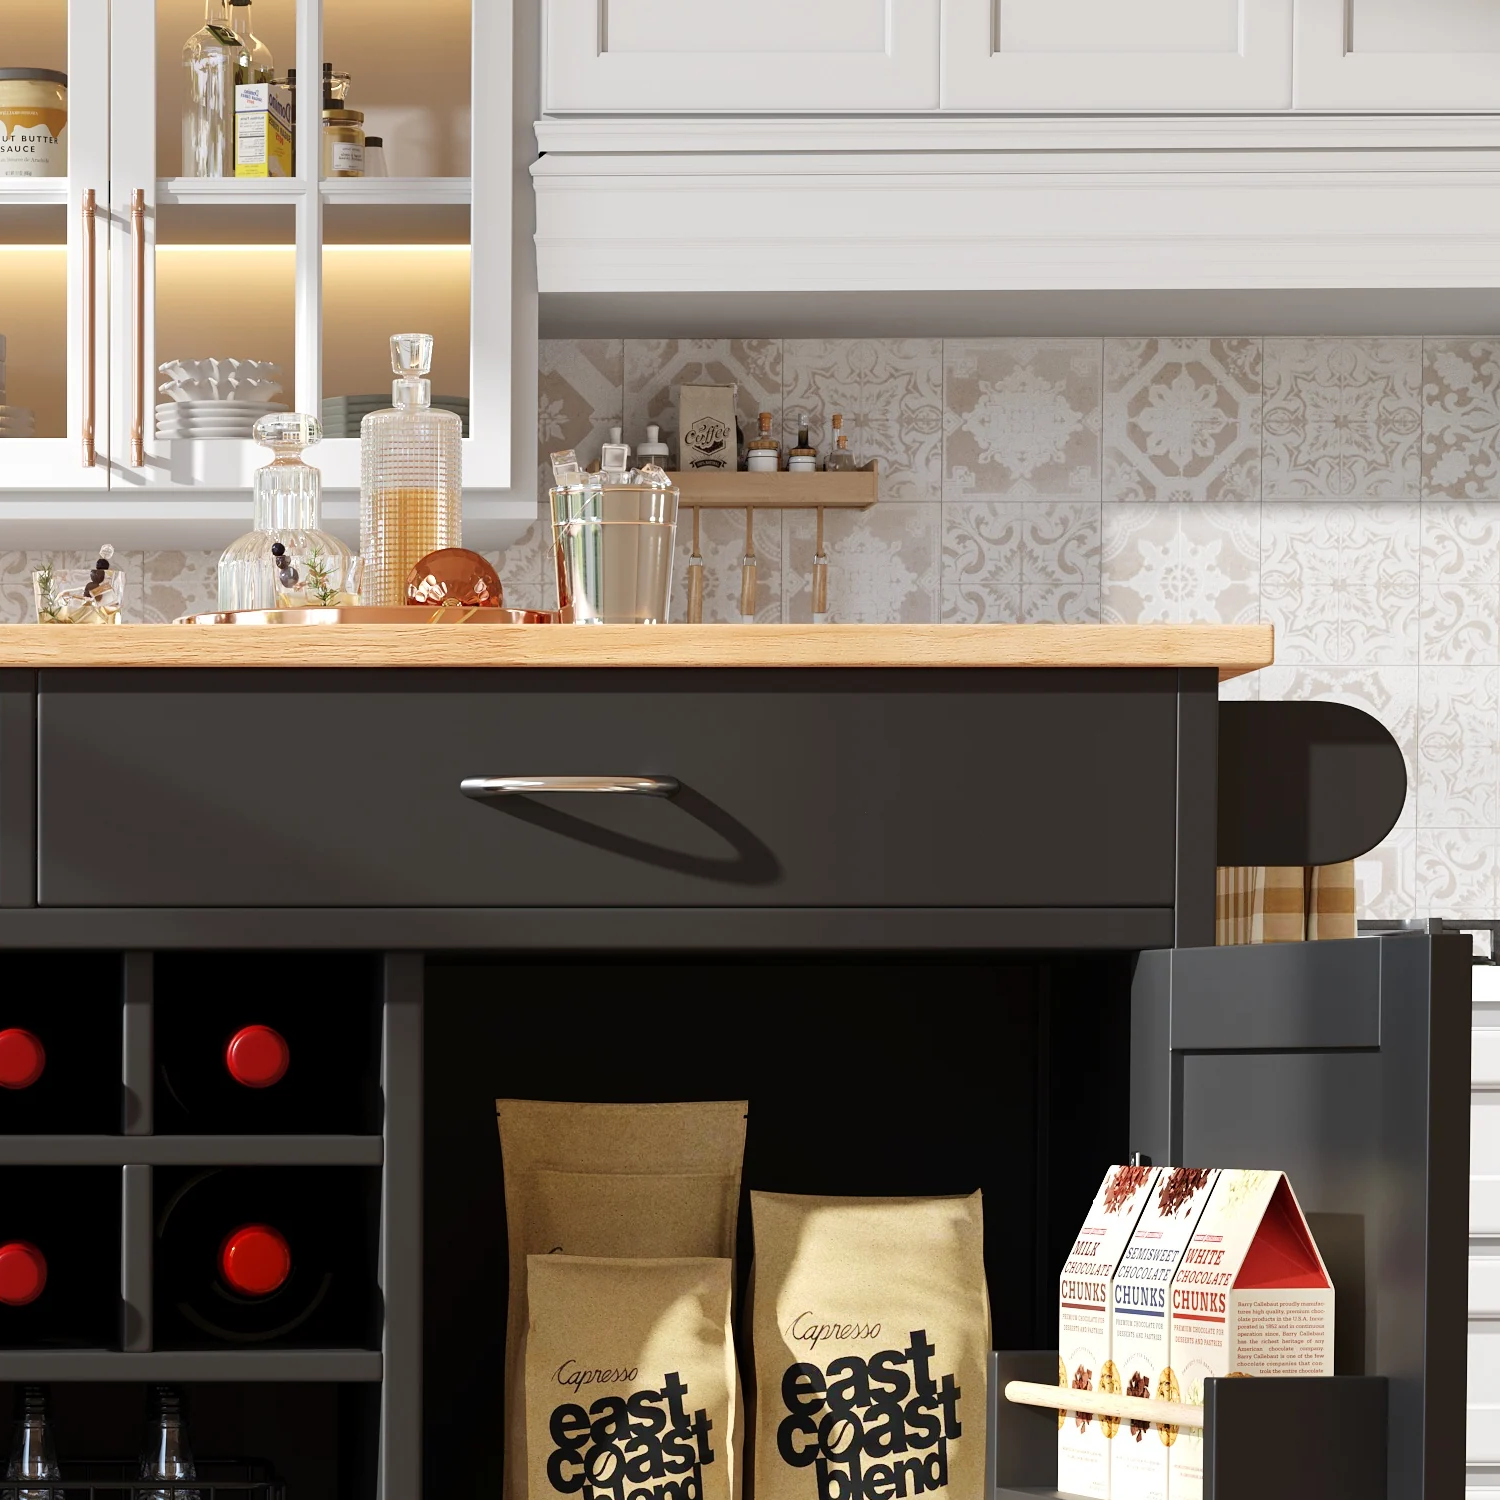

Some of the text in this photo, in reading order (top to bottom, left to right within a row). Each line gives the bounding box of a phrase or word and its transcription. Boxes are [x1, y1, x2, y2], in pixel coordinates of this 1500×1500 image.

[0, 145, 36, 153] SAUCE
[21, 135, 59, 145] BUTTER
[684, 424, 731, 446] Coffee
[1072, 1240, 1101, 1257] MILK
[1125, 1247, 1180, 1262] SEMISWEET
[1185, 1248, 1226, 1266] WHITE
[1064, 1261, 1113, 1277] CHOCOLATE
[1117, 1265, 1172, 1282] CHOCOLATE
[1176, 1269, 1233, 1286] CHOCOLATE
[1061, 1279, 1107, 1303] CHUNKS
[1114, 1284, 1165, 1308] CHUNKS
[1172, 1289, 1226, 1314] CHUNKS
[785, 1310, 882, 1350] Capresso
[551, 1359, 639, 1394] Capresso
[781, 1329, 937, 1417] east
[549, 1371, 693, 1451] east
[776, 1373, 962, 1468] coast
[546, 1408, 715, 1494] coast
